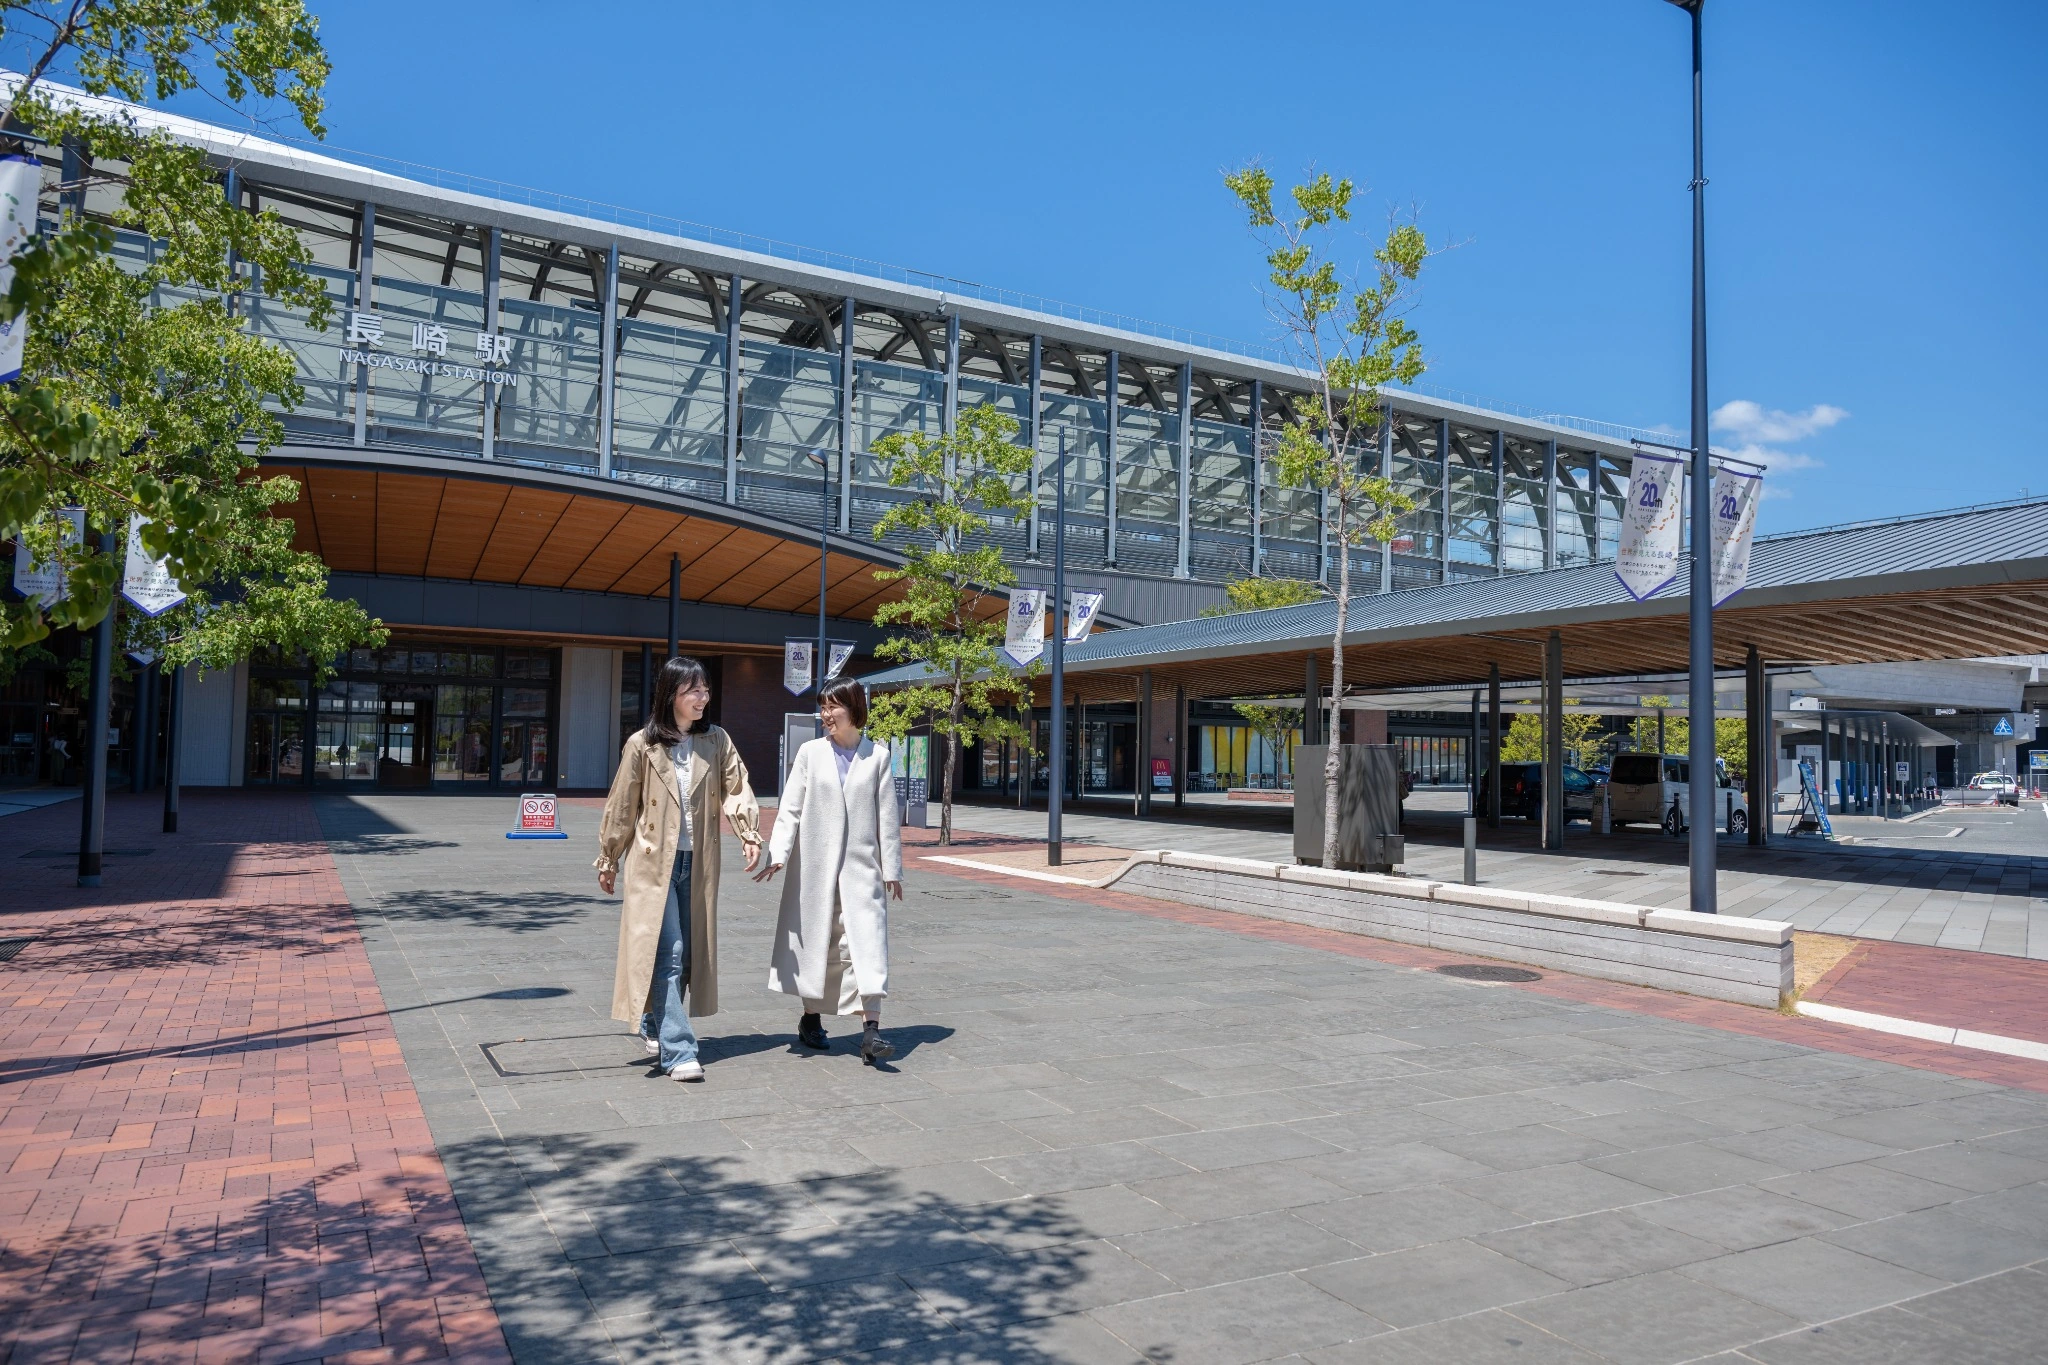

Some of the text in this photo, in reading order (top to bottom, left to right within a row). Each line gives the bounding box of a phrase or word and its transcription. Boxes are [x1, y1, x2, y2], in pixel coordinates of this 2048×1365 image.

[346, 312, 511, 366] 長崎駅
[339, 348, 518, 388] NAGASAKI STATION
